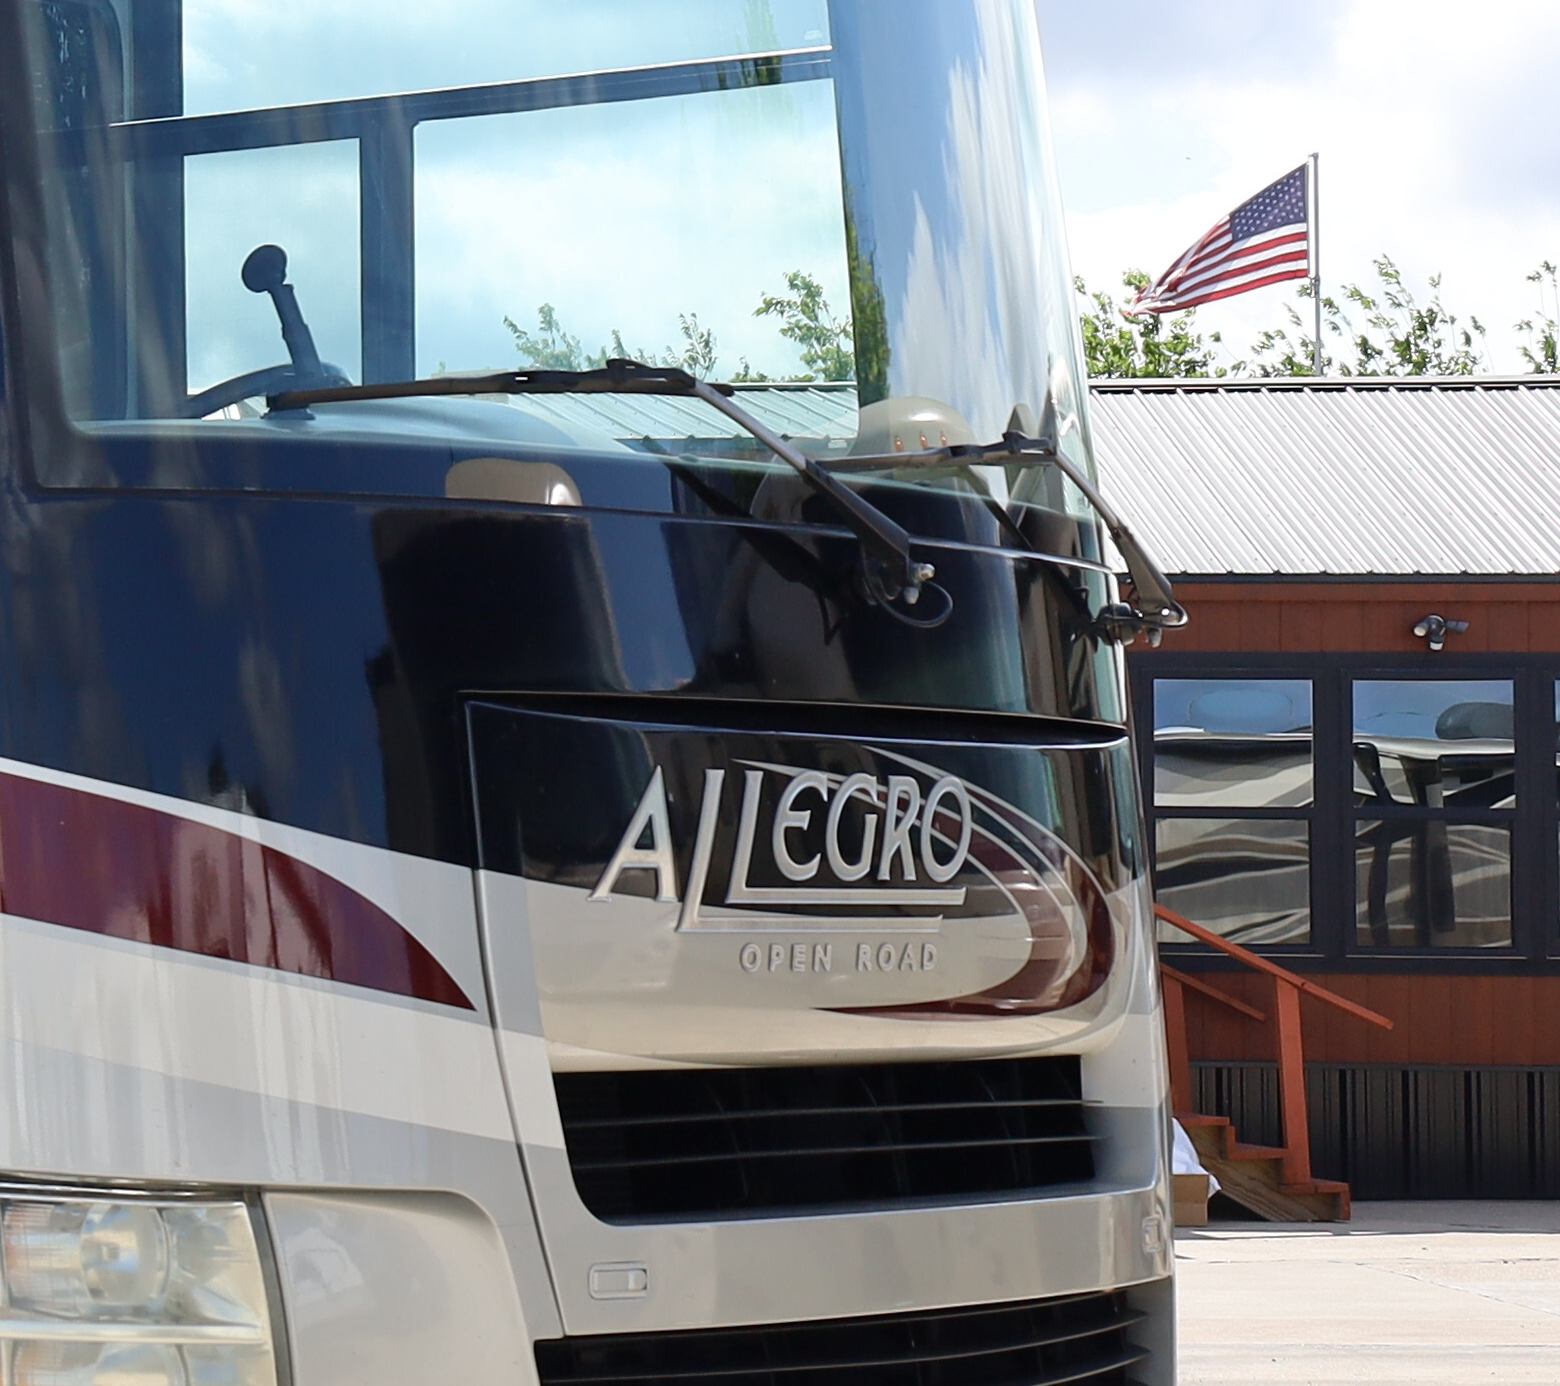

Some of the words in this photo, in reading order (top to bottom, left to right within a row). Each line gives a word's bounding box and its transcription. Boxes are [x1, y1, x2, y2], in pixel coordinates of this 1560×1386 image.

[587, 765, 972, 932] ALLEGRO
[741, 943, 833, 973] OPEN
[856, 943, 938, 973] ROAD
